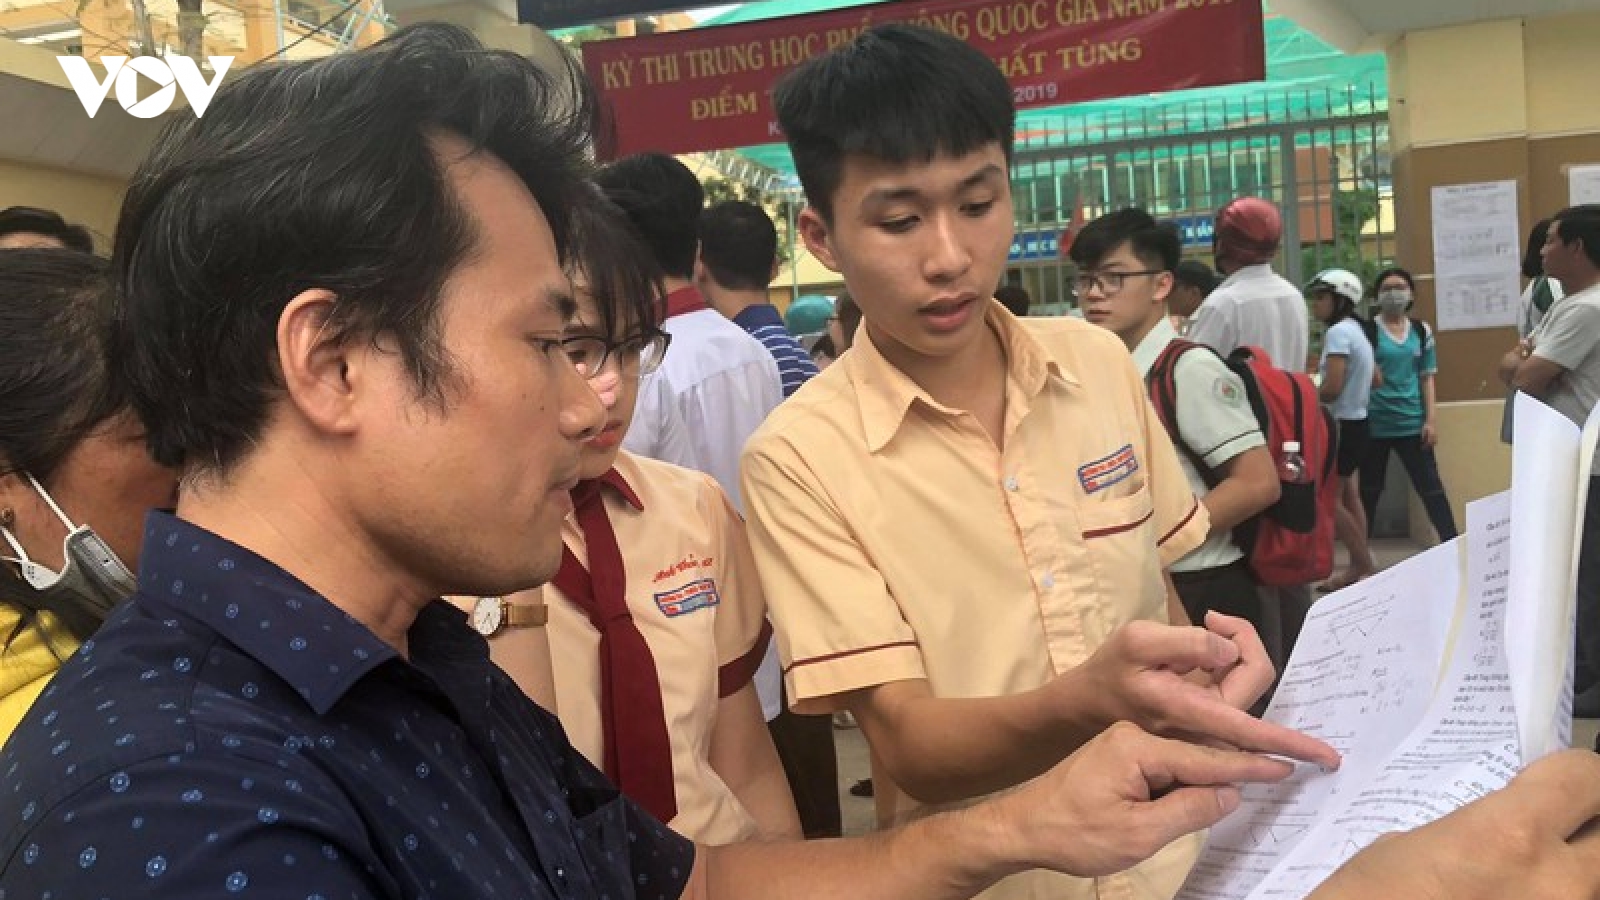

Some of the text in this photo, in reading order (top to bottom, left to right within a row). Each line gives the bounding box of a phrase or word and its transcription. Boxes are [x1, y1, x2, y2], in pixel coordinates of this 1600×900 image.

[640, 53, 680, 85] THI
[684, 40, 764, 79] TRUNG
[1055, 0, 1100, 27] GIA
[1056, 37, 1143, 71] TÙNG
[1013, 82, 1058, 103] 2019
